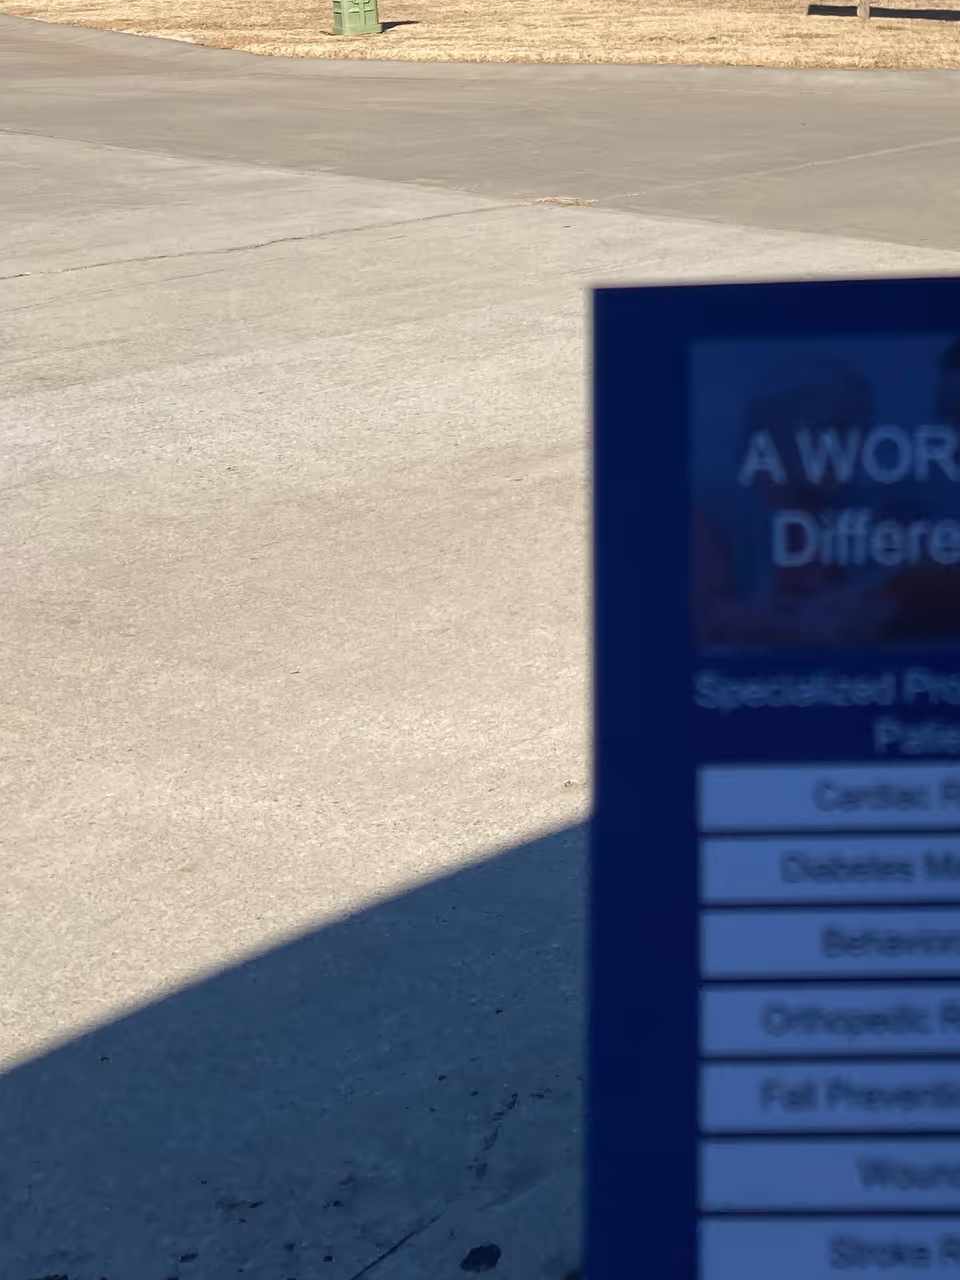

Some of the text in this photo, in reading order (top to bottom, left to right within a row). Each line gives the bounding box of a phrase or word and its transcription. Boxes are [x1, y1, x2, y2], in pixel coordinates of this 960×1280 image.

[738, 429, 787, 485] A
[693, 668, 897, 713] Specialized
[811, 777, 931, 813] Cardiac
[779, 849, 916, 885] Diabetes
[761, 1001, 932, 1040] Orthopedic
[761, 1076, 818, 1112] Fall
[827, 1232, 931, 1271] Stroke
